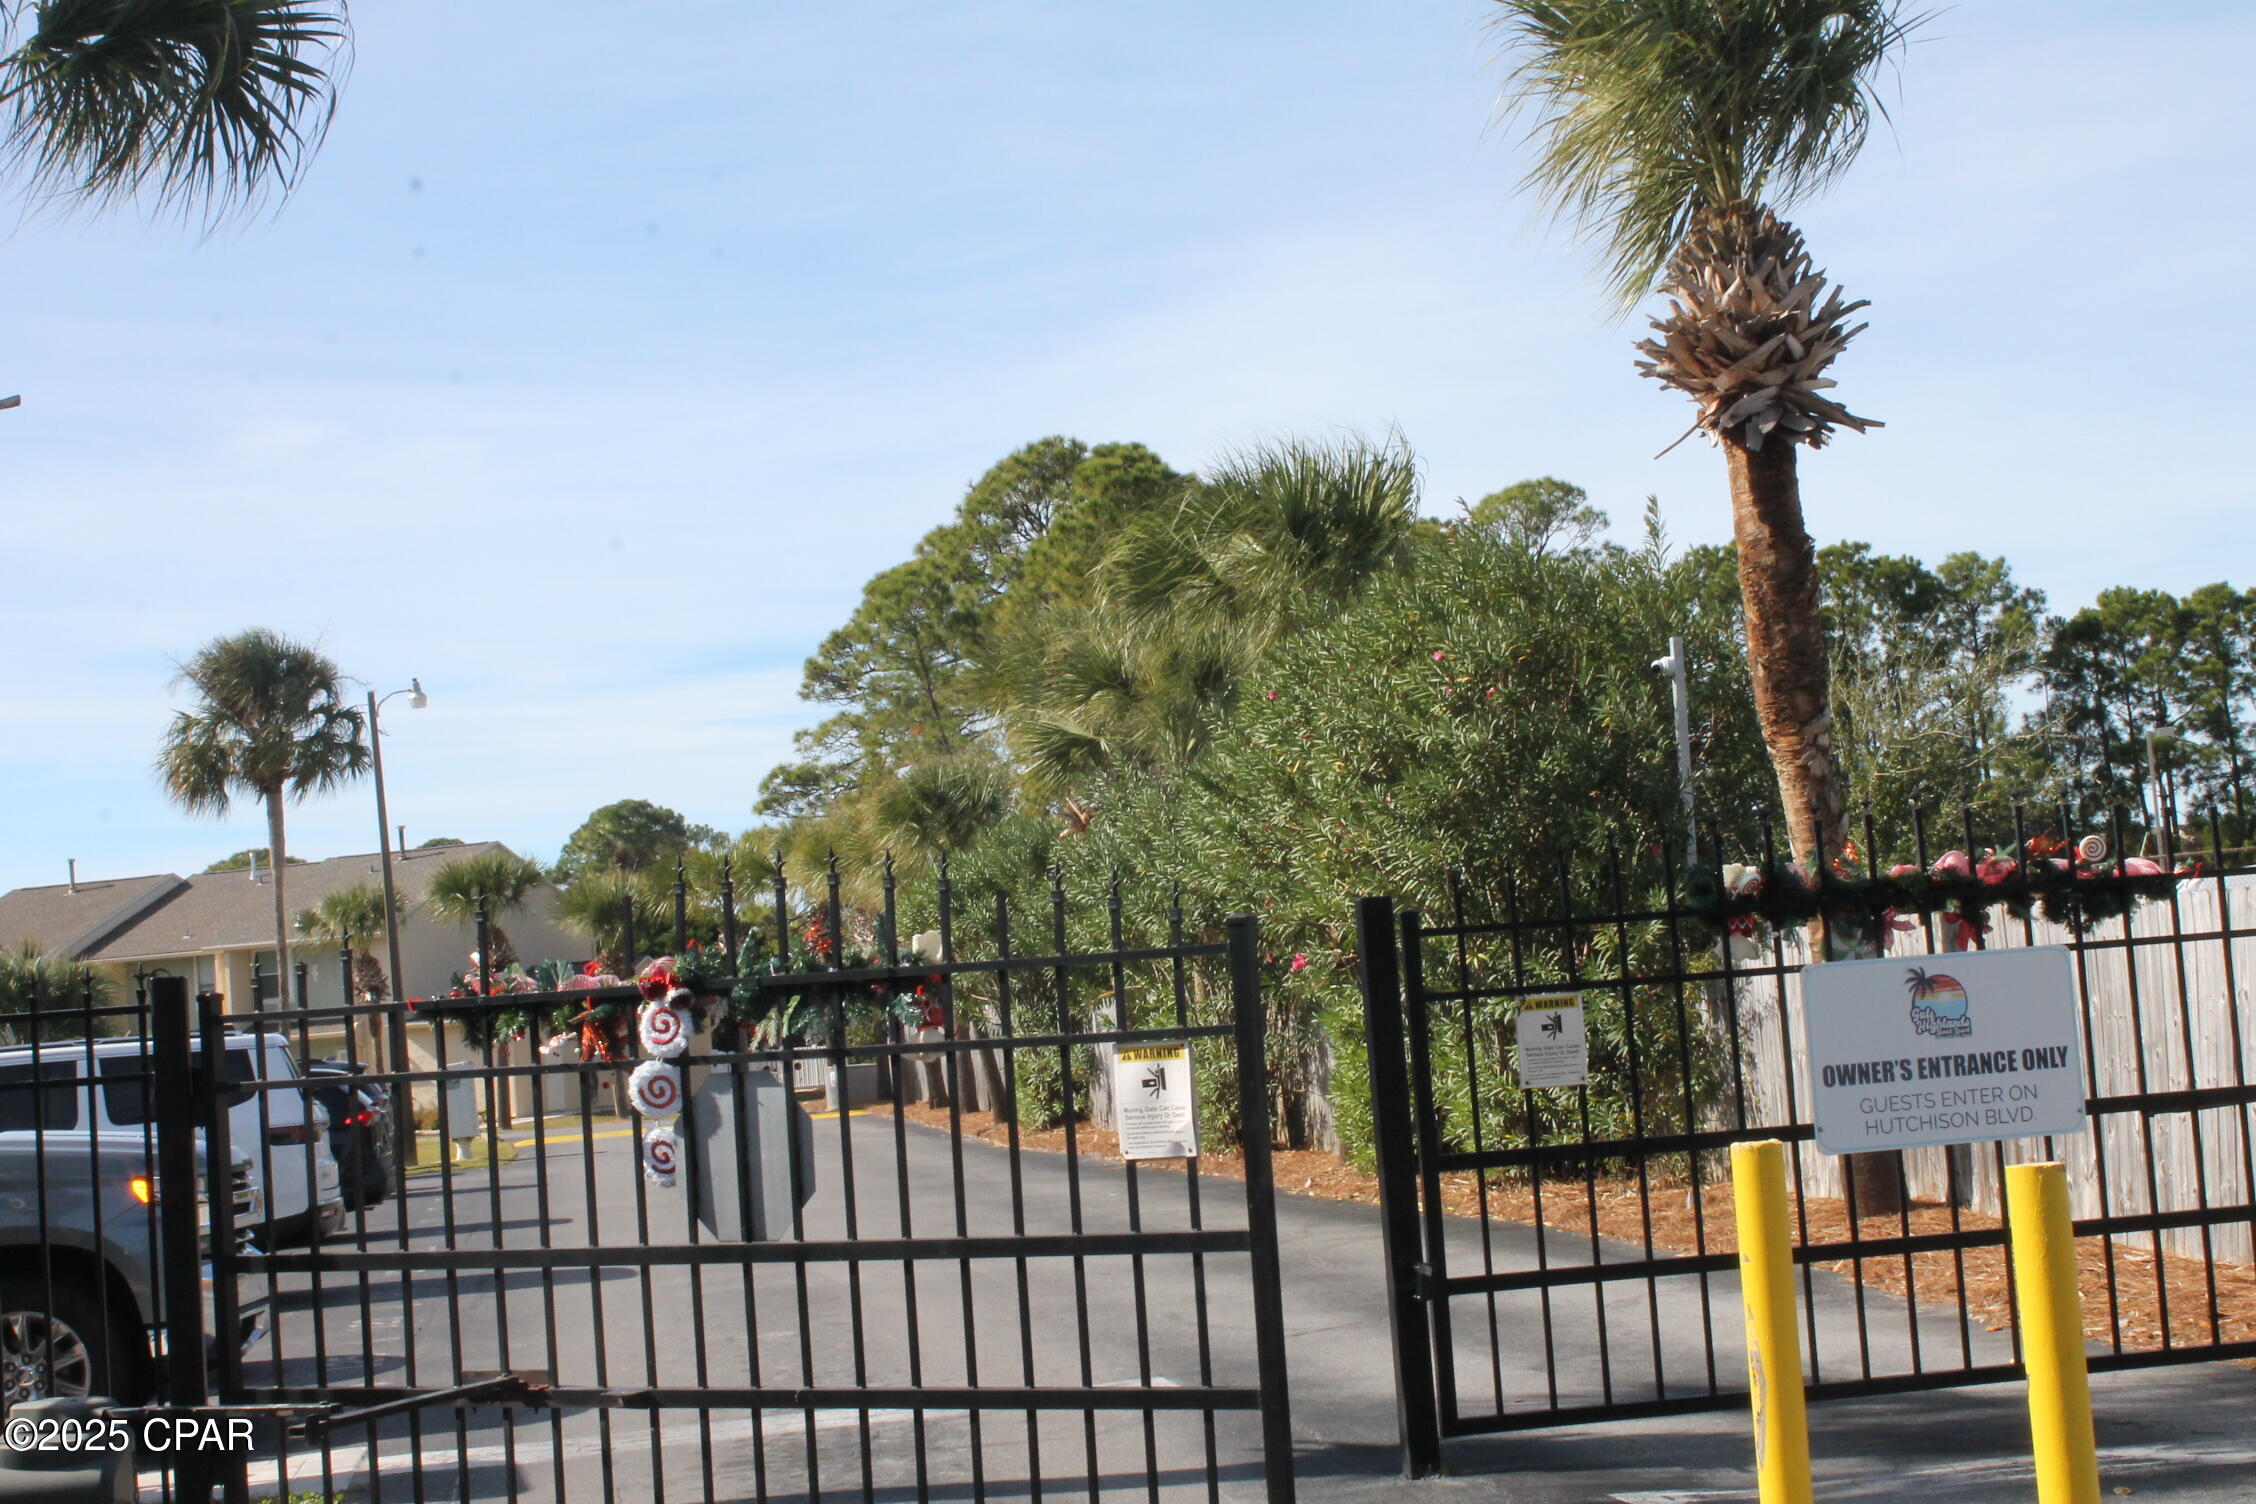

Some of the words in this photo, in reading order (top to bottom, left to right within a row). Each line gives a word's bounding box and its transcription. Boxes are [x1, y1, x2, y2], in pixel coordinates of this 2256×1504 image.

[1535, 997, 1575, 1008] WARNING
[1916, 1014, 1970, 1034] Highlands
[1134, 1047, 1181, 1060] WARNING
[1822, 1058, 1912, 1088] OWNER'S
[1917, 1050, 2018, 1080] ENTRANCE
[2021, 1045, 2068, 1071] ONLY
[1859, 1092, 1936, 1114] GUESTS
[1941, 1087, 2004, 1108] ENTER
[2008, 1083, 2038, 1103] ON
[1865, 1111, 1980, 1137] HUTCHISON
[1985, 1105, 2037, 1126] BLVD.
